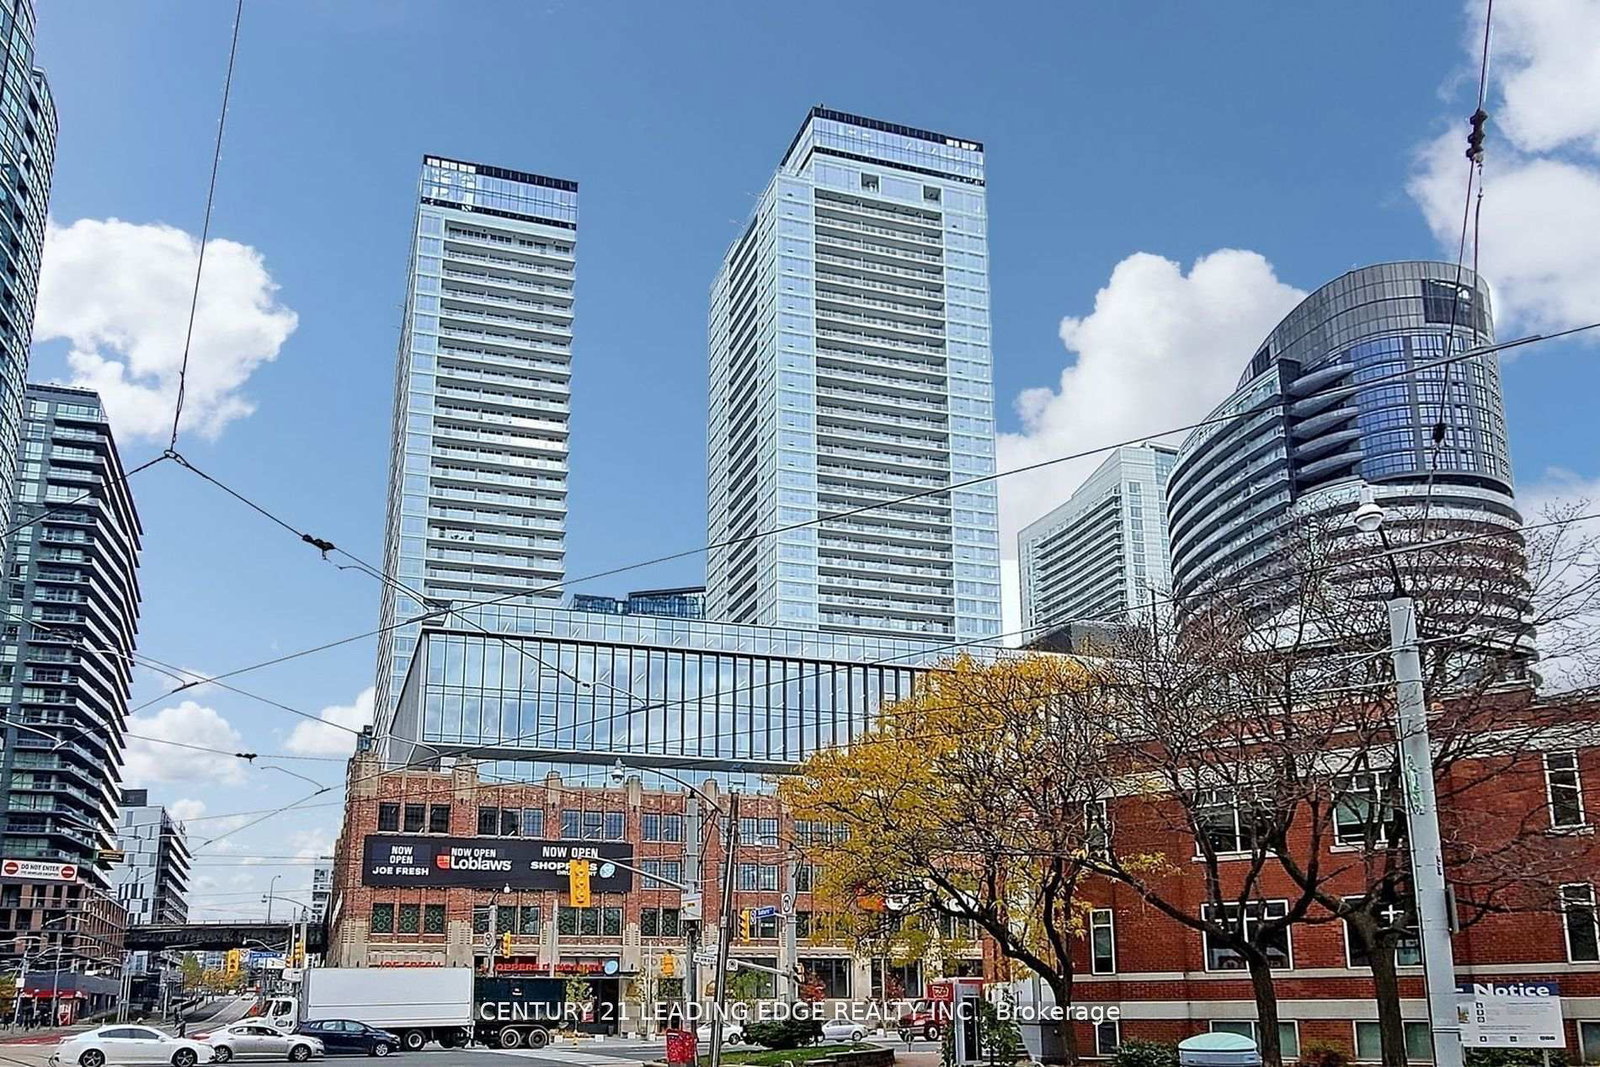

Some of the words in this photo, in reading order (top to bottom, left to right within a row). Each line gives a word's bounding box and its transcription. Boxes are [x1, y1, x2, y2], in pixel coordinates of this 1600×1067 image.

[391, 846, 413, 855] NOW
[451, 848, 473, 857] NOW
[473, 848, 497, 858] OPEN
[542, 846, 568, 858] NOW
[571, 847, 599, 858] OPEN
[389, 855, 413, 864] OPEN
[450, 856, 513, 871] Loblaws
[372, 866, 393, 875] JOE
[395, 867, 429, 876] FRESH
[530, 861, 598, 871] SHOPPS
[1473, 983, 1550, 997] Notice
